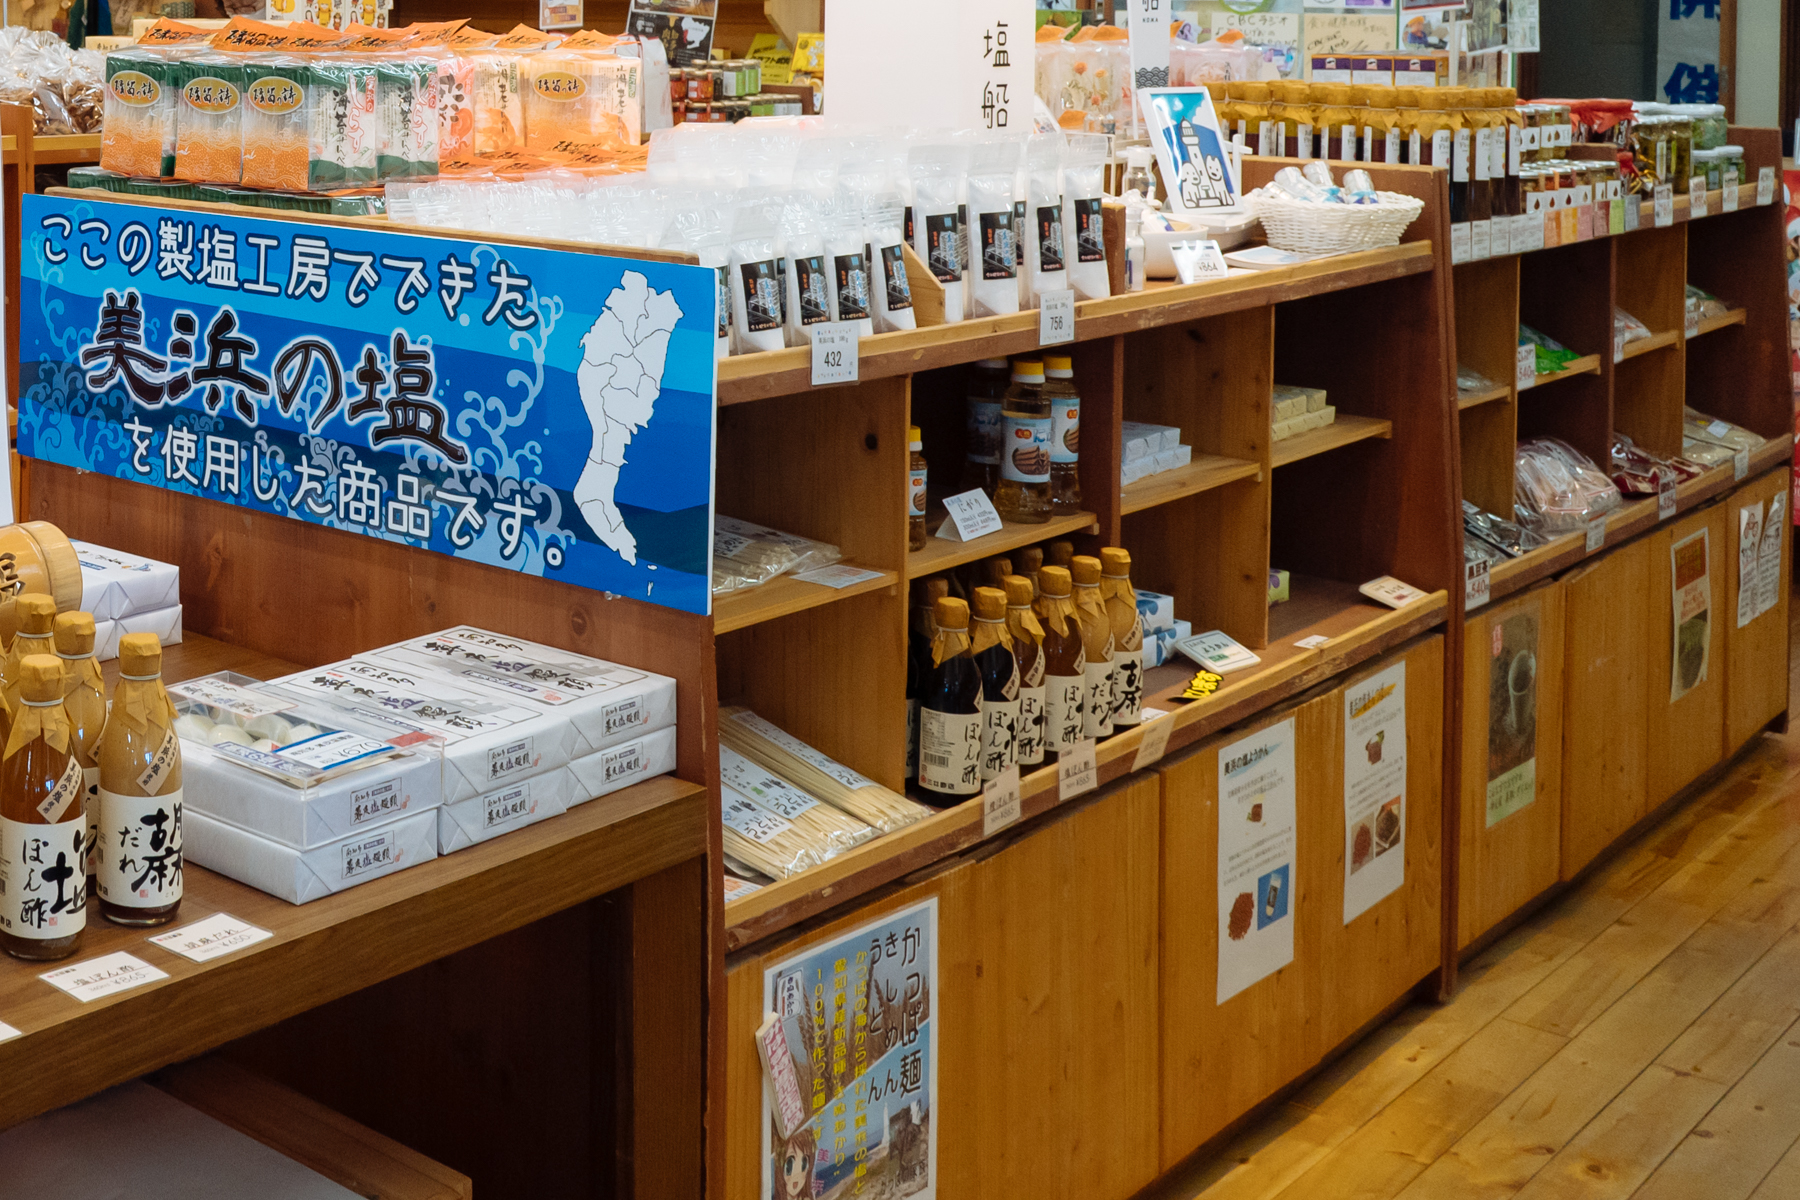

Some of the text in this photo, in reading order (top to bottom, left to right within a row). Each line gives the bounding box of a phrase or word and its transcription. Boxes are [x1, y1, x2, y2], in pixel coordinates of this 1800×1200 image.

[981, 20, 1011, 129] 塩船
[40, 211, 540, 331] ここの製塩工房でできた
[1049, 316, 1063, 331] 756
[82, 289, 469, 465] 美浜の塩
[824, 351, 842, 368] 432
[122, 414, 567, 569] を使用した商品です。
[20, 838, 50, 930] ぽん酢
[118, 826, 144, 873] だれ
[900, 926, 922, 1098] かっぱ麺
